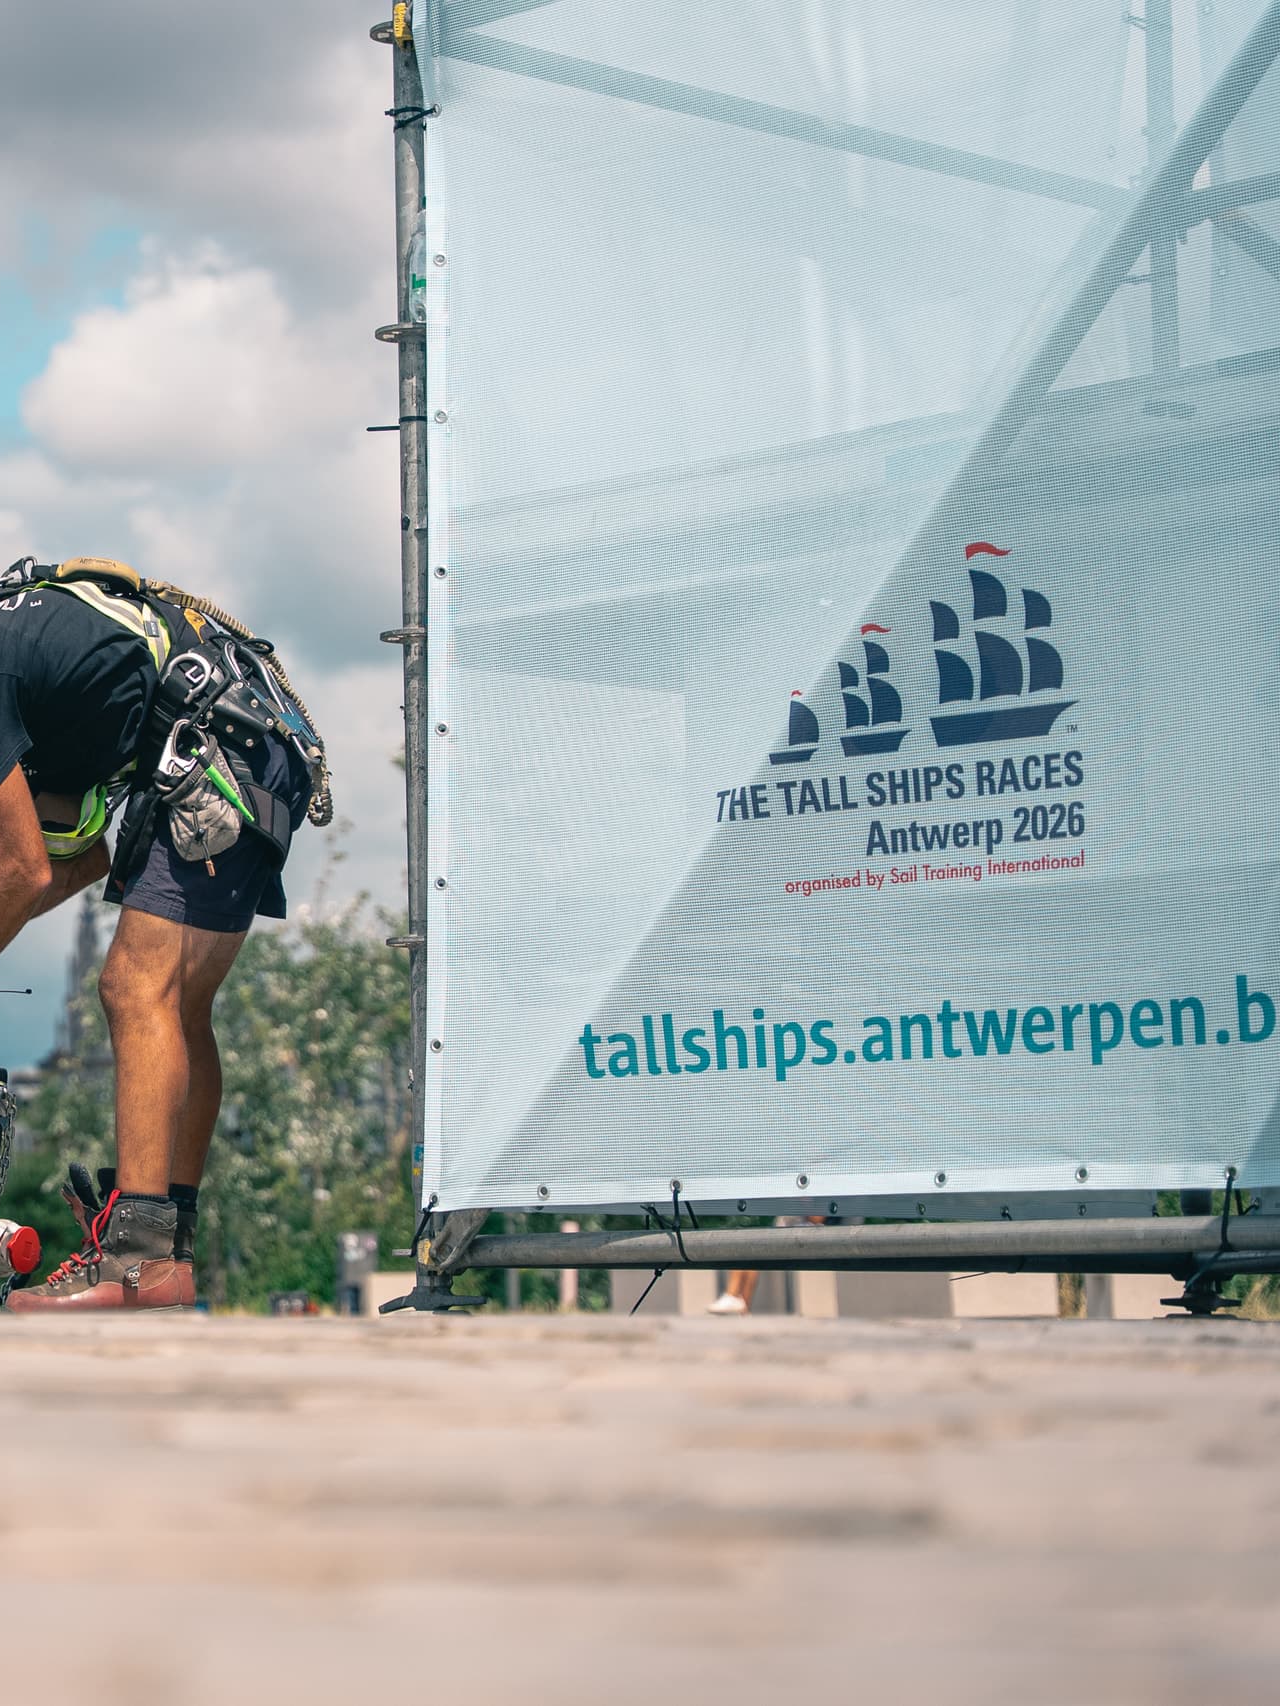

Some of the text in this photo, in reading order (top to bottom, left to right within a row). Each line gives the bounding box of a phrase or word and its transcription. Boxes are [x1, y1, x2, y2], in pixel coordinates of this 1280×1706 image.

[716, 750, 1084, 822] THE TALL SHIPS RACES
[866, 801, 1085, 856] Antwerp 2026
[785, 850, 1085, 896] organised by Sail Training International
[578, 974, 1276, 1082] tallships.antwerpen.b
